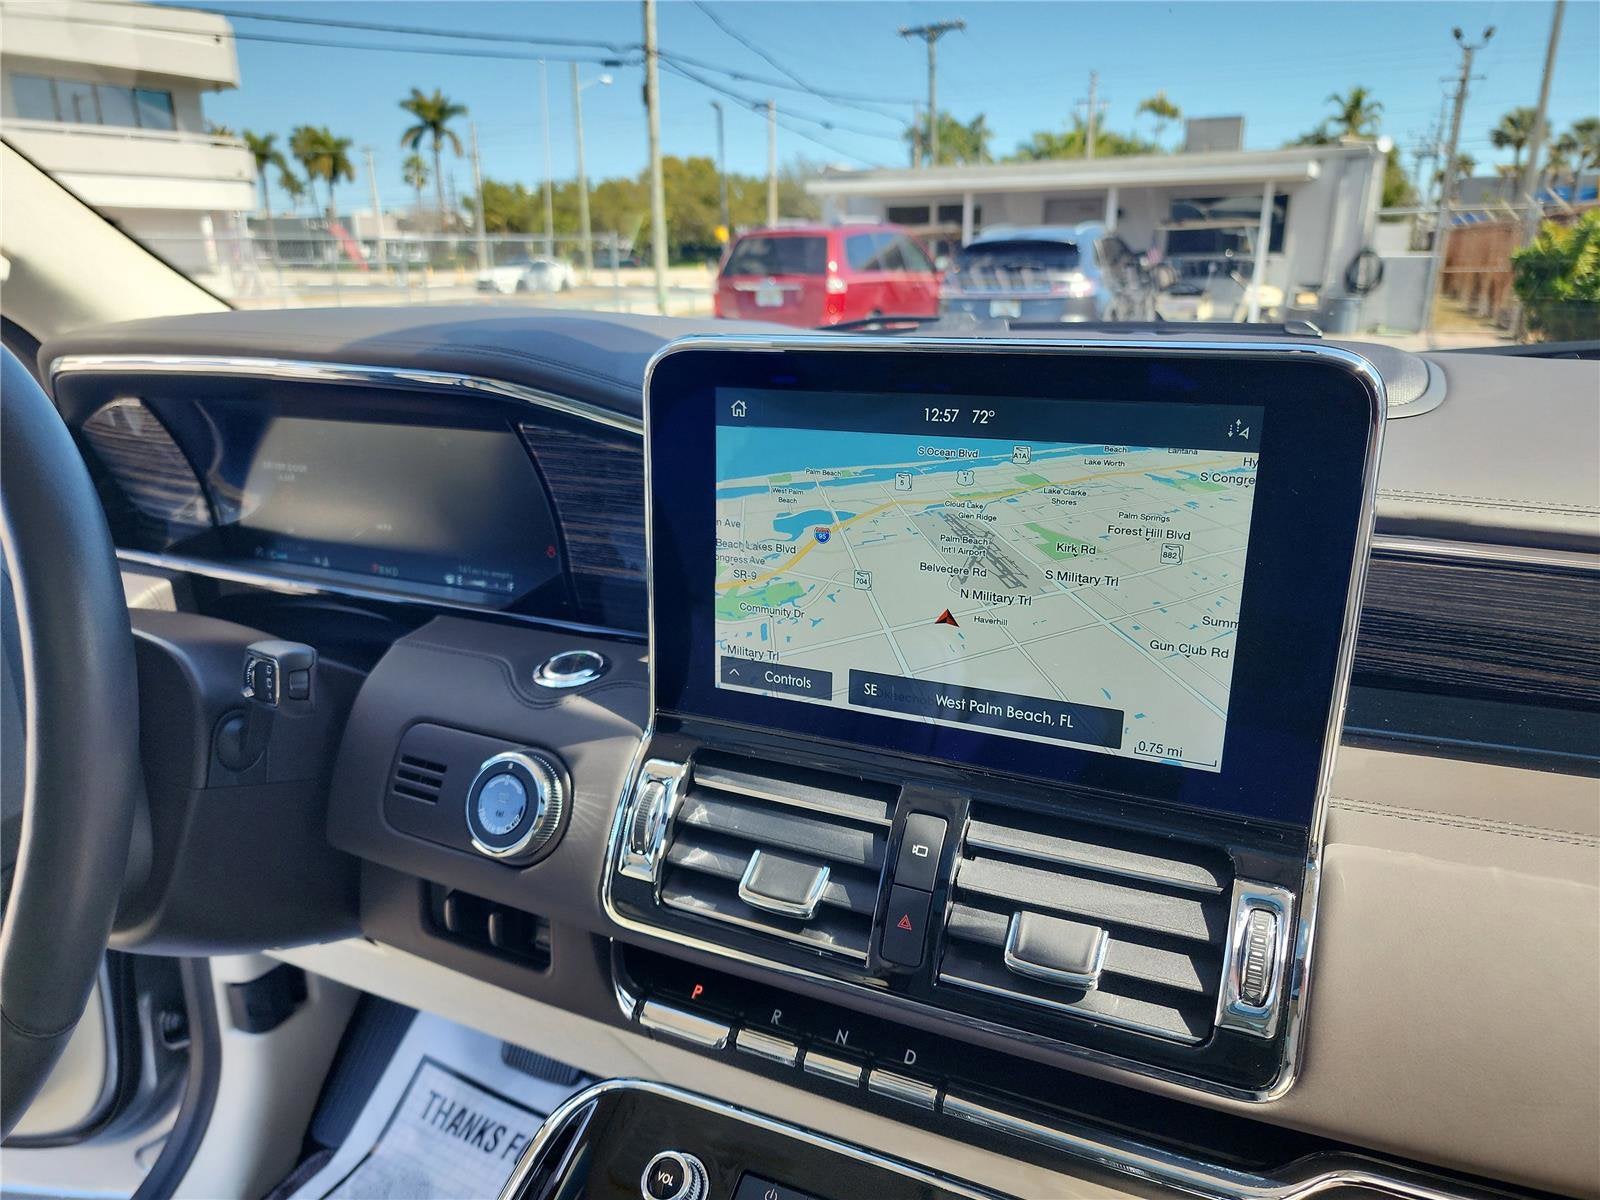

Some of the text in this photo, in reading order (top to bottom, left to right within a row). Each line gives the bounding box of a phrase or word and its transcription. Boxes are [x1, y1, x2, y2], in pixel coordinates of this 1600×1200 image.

[924, 408, 996, 424] 12:57 72°
[918, 447, 978, 458] S Ocean Blvd
[1104, 446, 1127, 454] Beach
[1200, 472, 1208, 482] S
[1043, 488, 1086, 497] Lake Clarke
[944, 500, 984, 510] Cloud Lake
[1051, 498, 1077, 506] Shores
[725, 518, 741, 528] Ave
[976, 512, 997, 522] Ridge
[1118, 512, 1170, 523] Palm Springs
[940, 534, 989, 546] Palm Beach
[1108, 525, 1191, 540] Forest Hill Blvd
[716, 538, 796, 554] Beach Lakes Blvd
[958, 547, 986, 557] Airport
[1056, 542, 1096, 555] Kirk Rd
[750, 556, 766, 565] Ave
[1162, 552, 1178, 560] 882
[733, 570, 757, 580] SR-9
[920, 562, 987, 578] Belvedere Rd
[1045, 570, 1119, 587] S Military Trl
[960, 588, 1032, 606] N Military Trl
[740, 602, 805, 619] Community Dr
[973, 616, 1008, 626] Haverhill
[727, 644, 780, 661] Military Trl
[1150, 640, 1229, 658] Gun Club Rd
[764, 670, 812, 688] Controls
[863, 683, 878, 696] SE
[935, 694, 966, 711] West
[970, 700, 1003, 716] Palm
[1007, 706, 1055, 726] Beach,
[1060, 714, 1074, 728] FL
[1138, 741, 1183, 758] 0.75 mi
[691, 984, 703, 1000] P
[770, 1008, 782, 1025] R
[836, 1030, 849, 1045] N
[904, 1050, 917, 1065] D
[420, 1090, 508, 1154] THANKS
[658, 1170, 674, 1186] VOL
